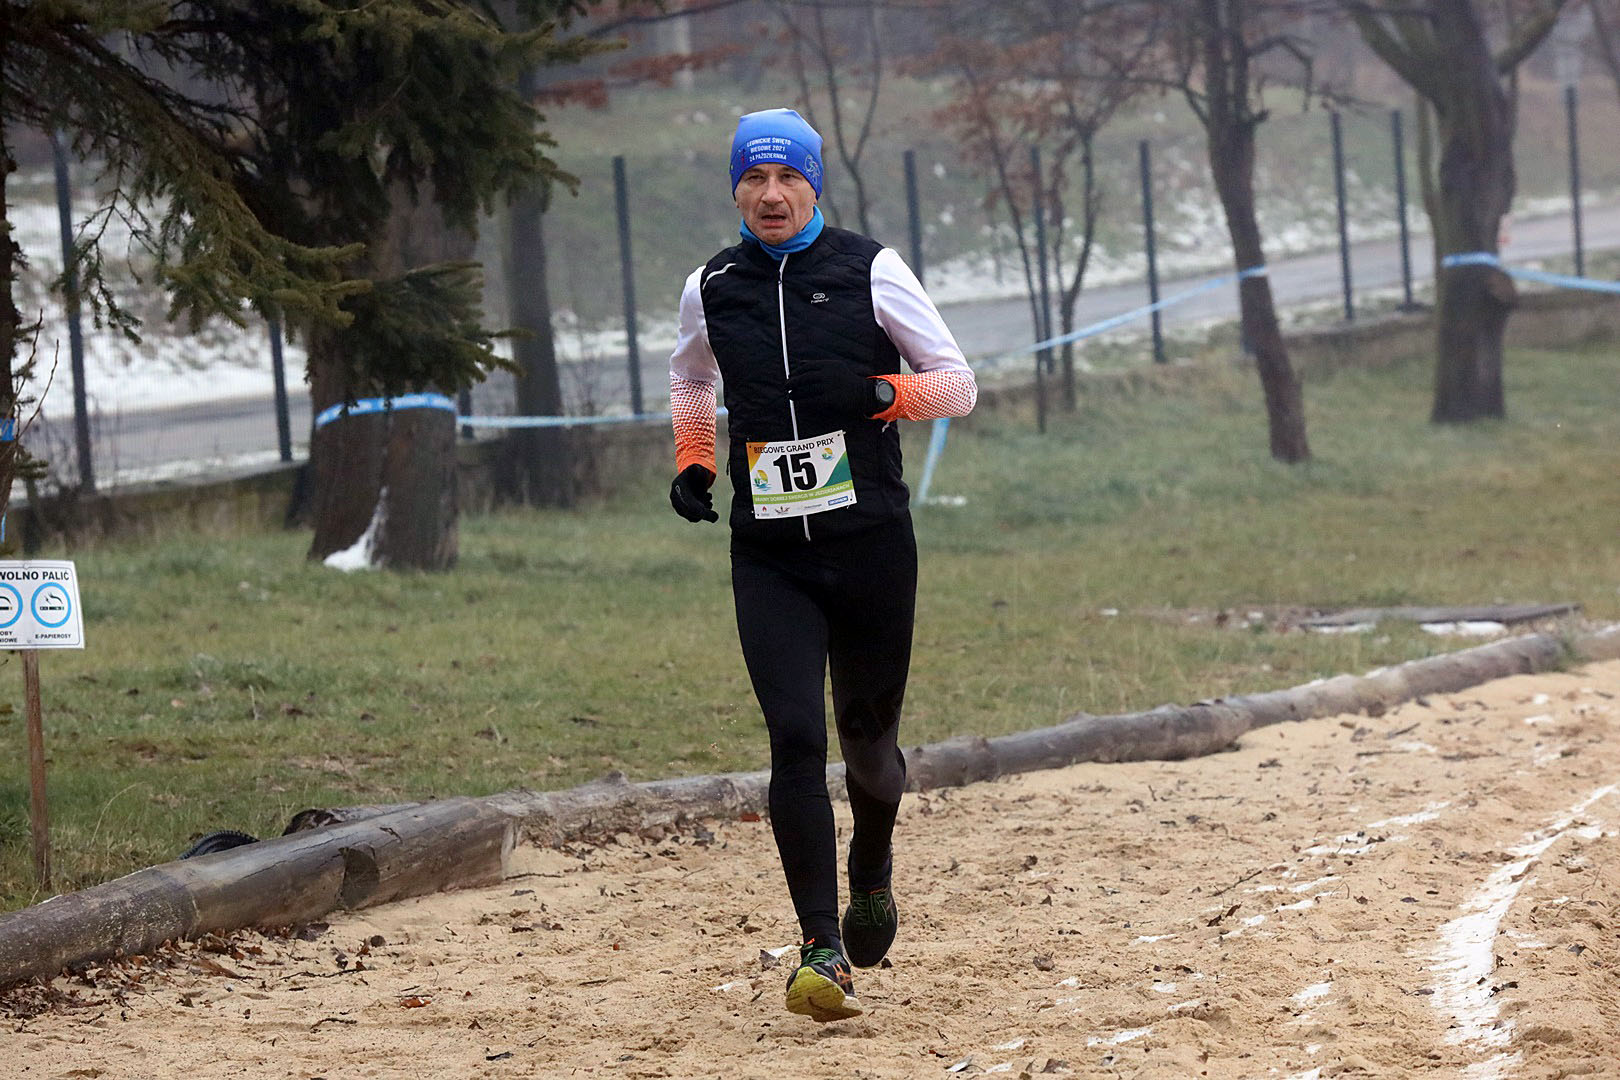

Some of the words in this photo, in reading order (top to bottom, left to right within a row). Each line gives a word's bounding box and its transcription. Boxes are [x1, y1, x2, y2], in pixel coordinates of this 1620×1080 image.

[750, 145, 772, 154] BIEGOWE
[753, 445, 785, 454] BIEGOWE
[786, 442, 815, 453] GRAND
[816, 437, 834, 448] PRIX
[773, 451, 818, 493] 15
[42, 570, 70, 581] PALIĆ
